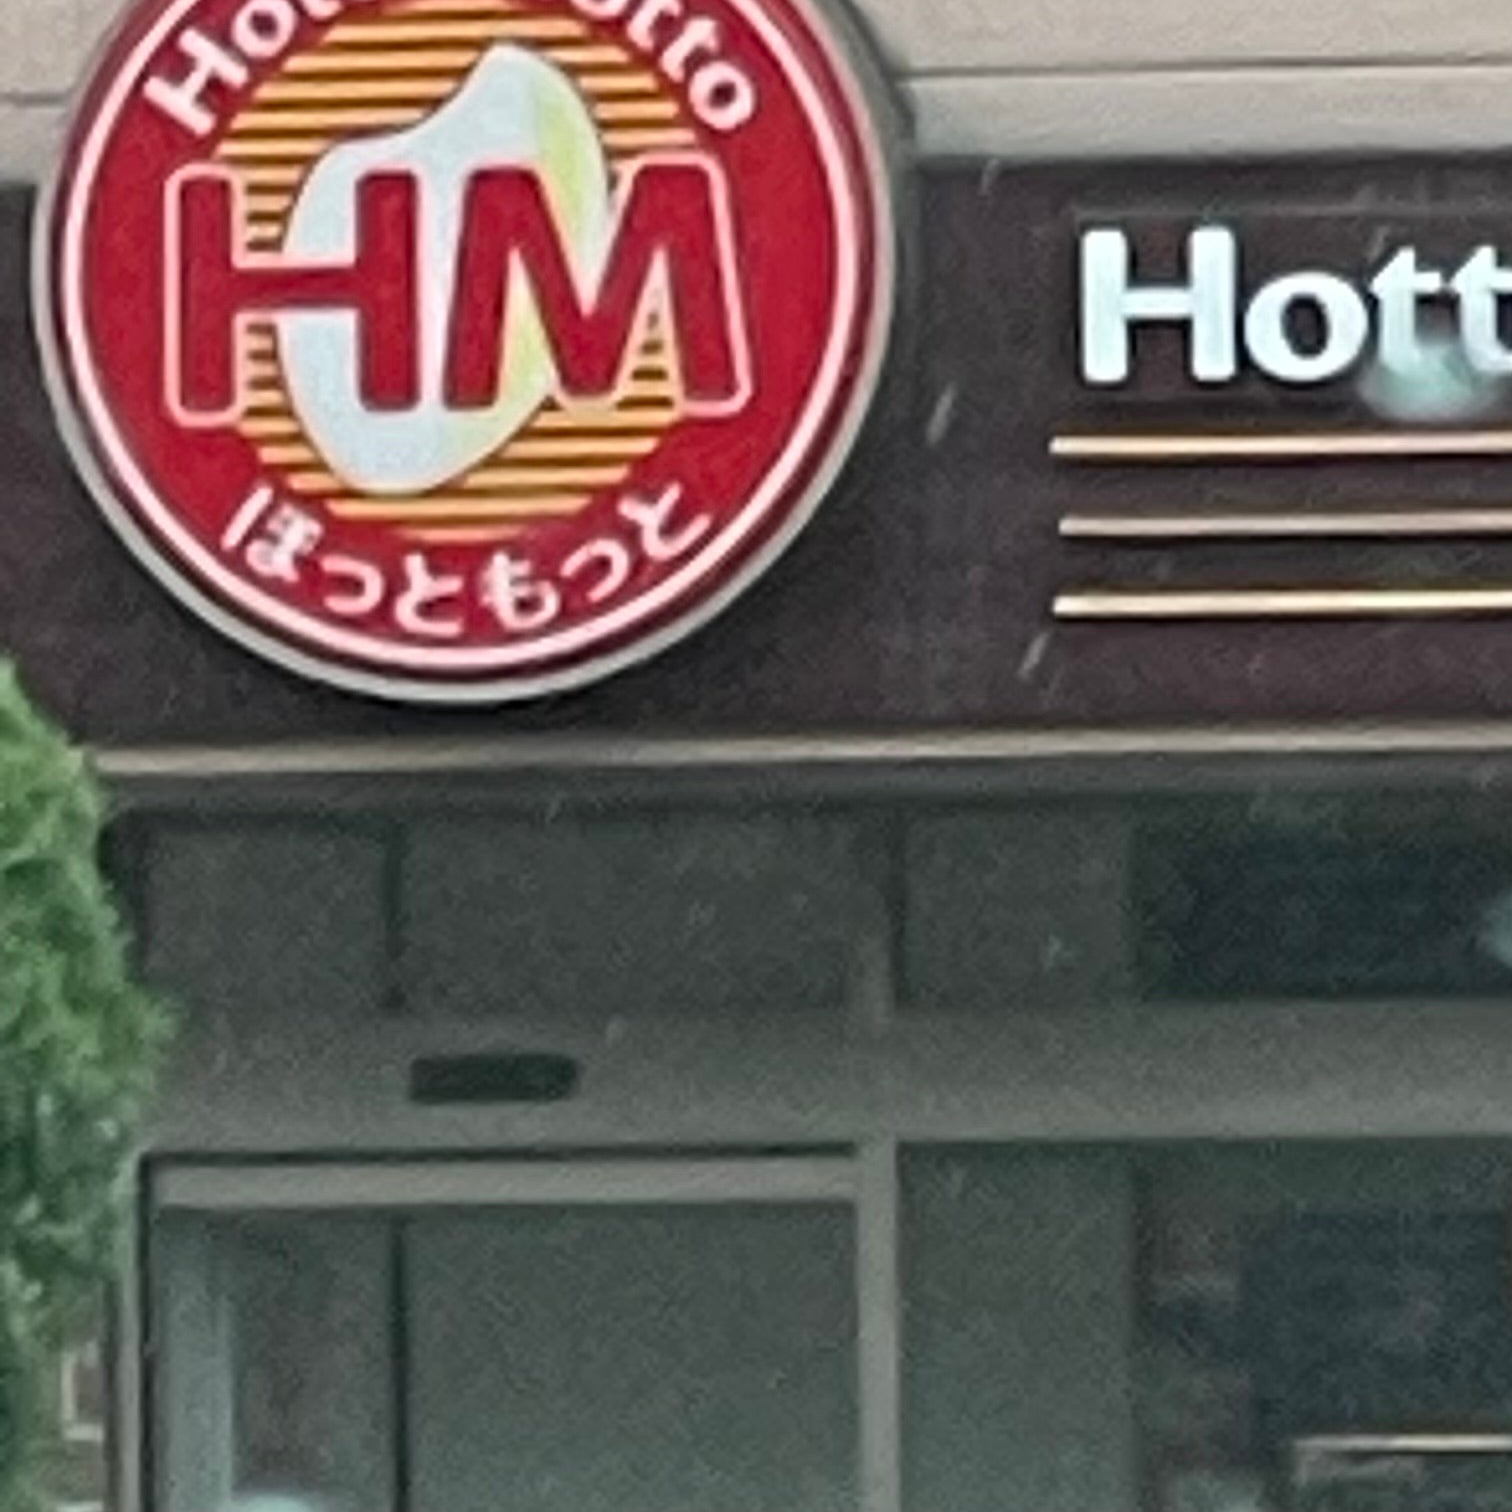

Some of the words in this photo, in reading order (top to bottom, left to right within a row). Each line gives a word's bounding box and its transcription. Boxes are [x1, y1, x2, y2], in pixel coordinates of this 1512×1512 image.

[164, 151, 754, 428] HM
[222, 483, 712, 638] ほっともっと
